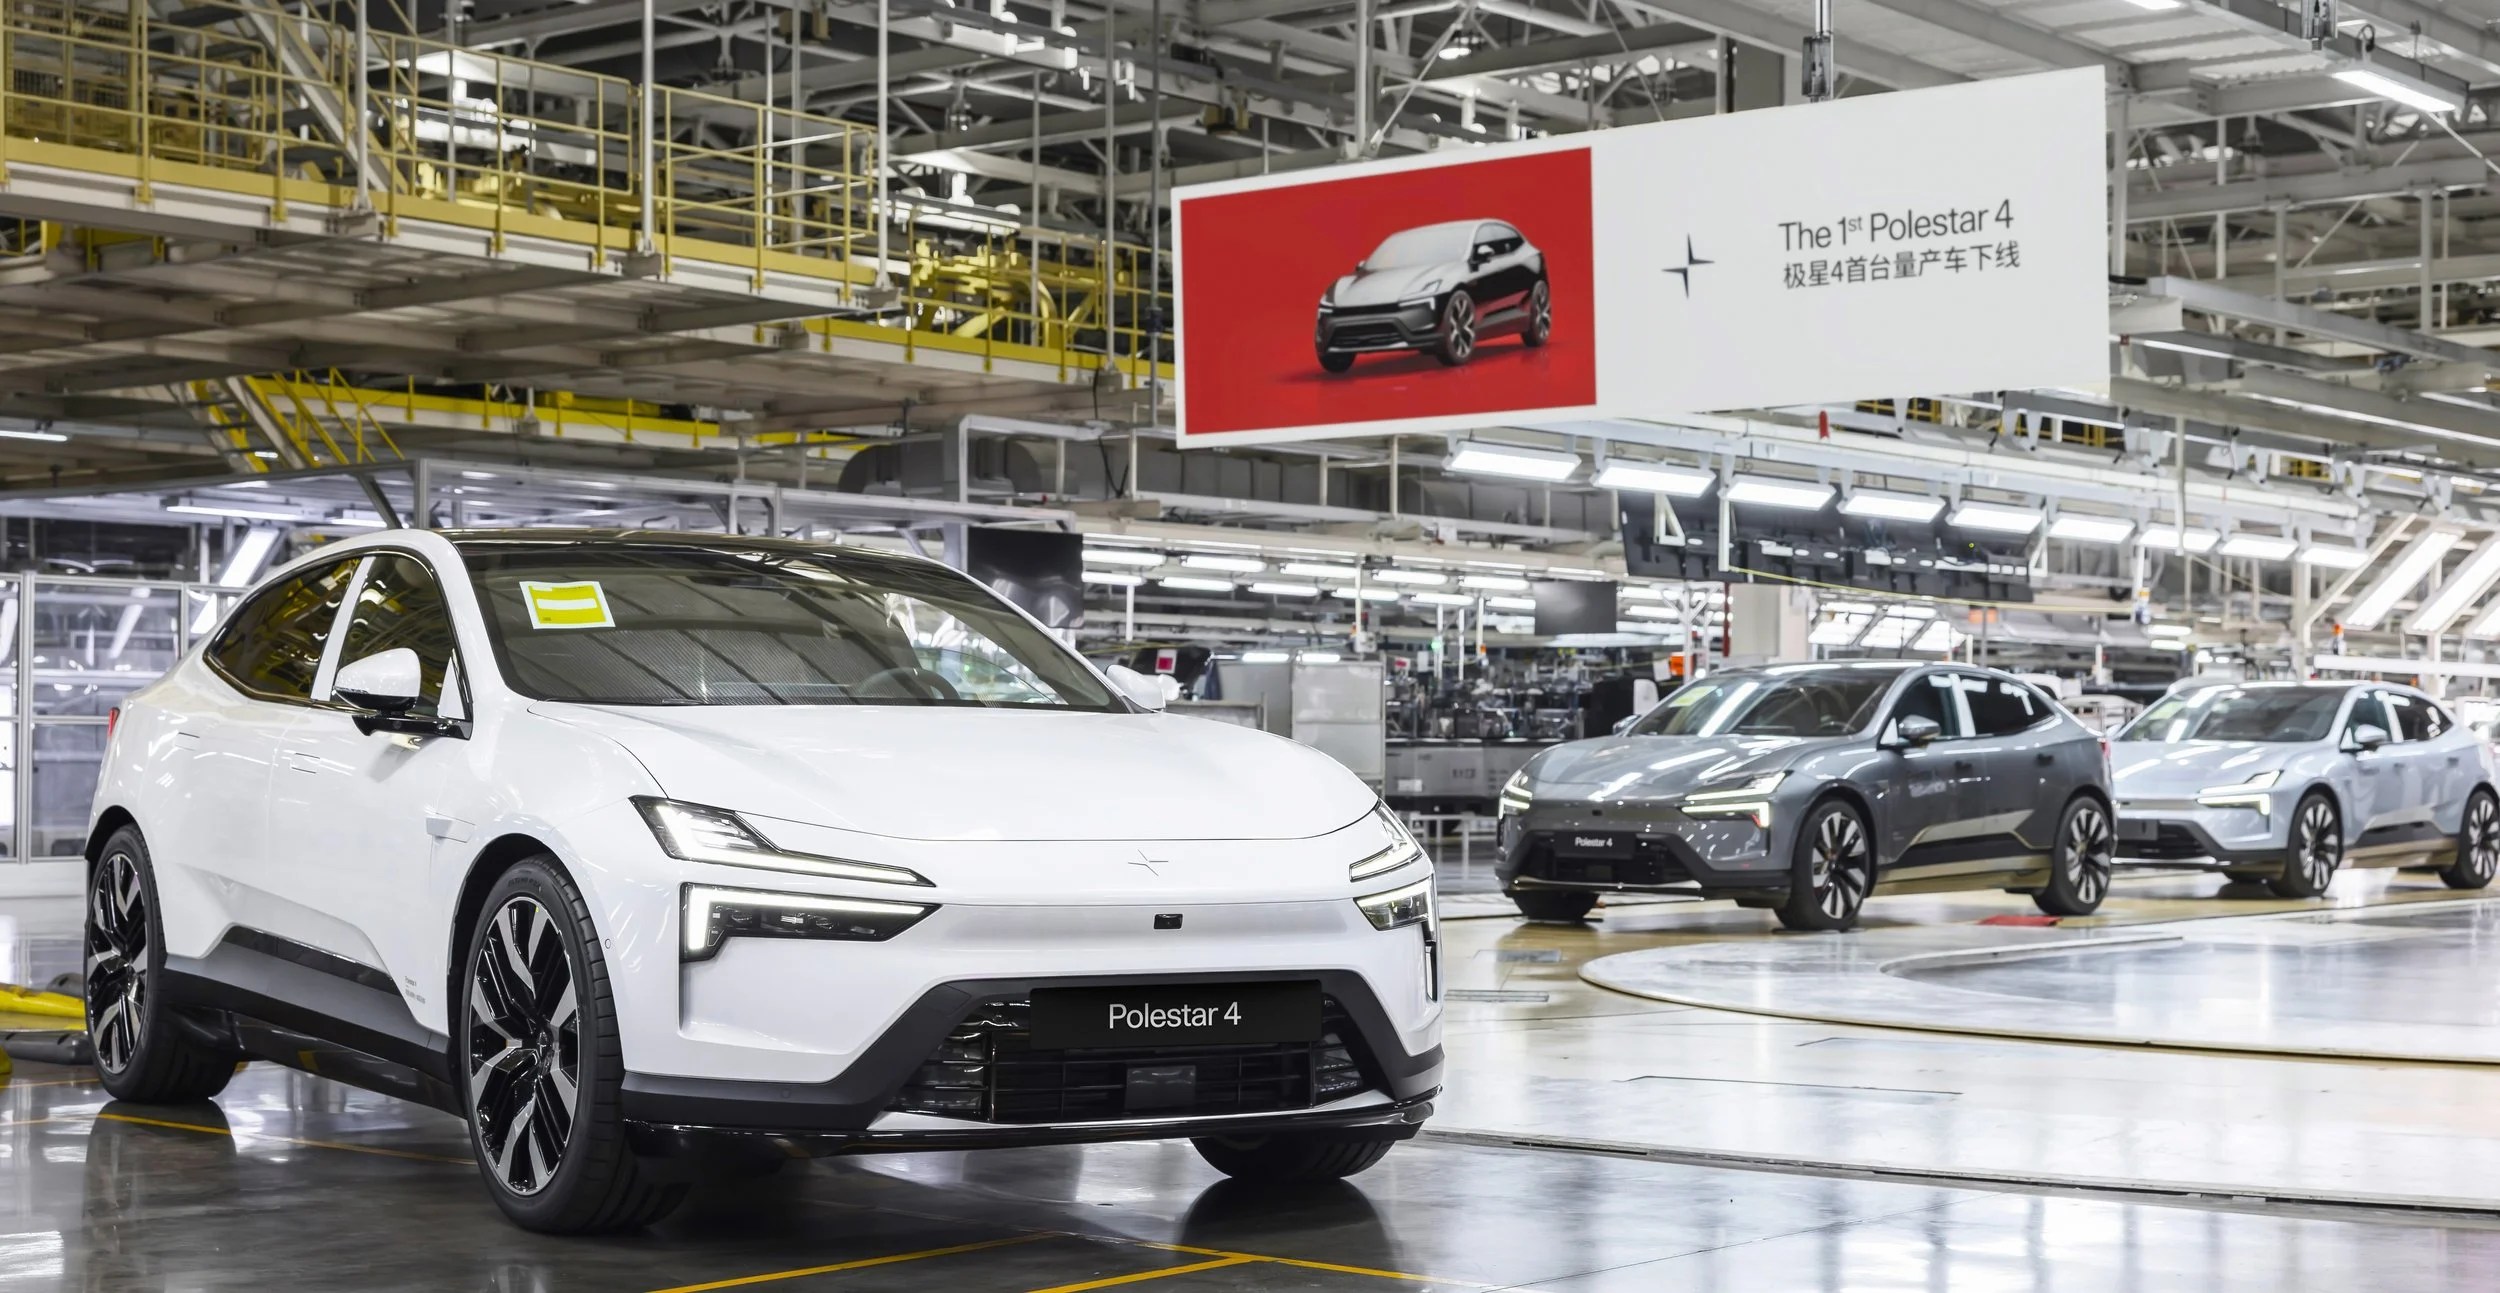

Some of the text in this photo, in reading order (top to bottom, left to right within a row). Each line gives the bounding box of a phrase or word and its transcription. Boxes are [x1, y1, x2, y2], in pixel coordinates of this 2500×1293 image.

[1778, 198, 2014, 251] The 1st Polestar 4
[1783, 240, 2020, 289] 极星4首台量产车下线
[1109, 1001, 1242, 1029] Polestar 4
